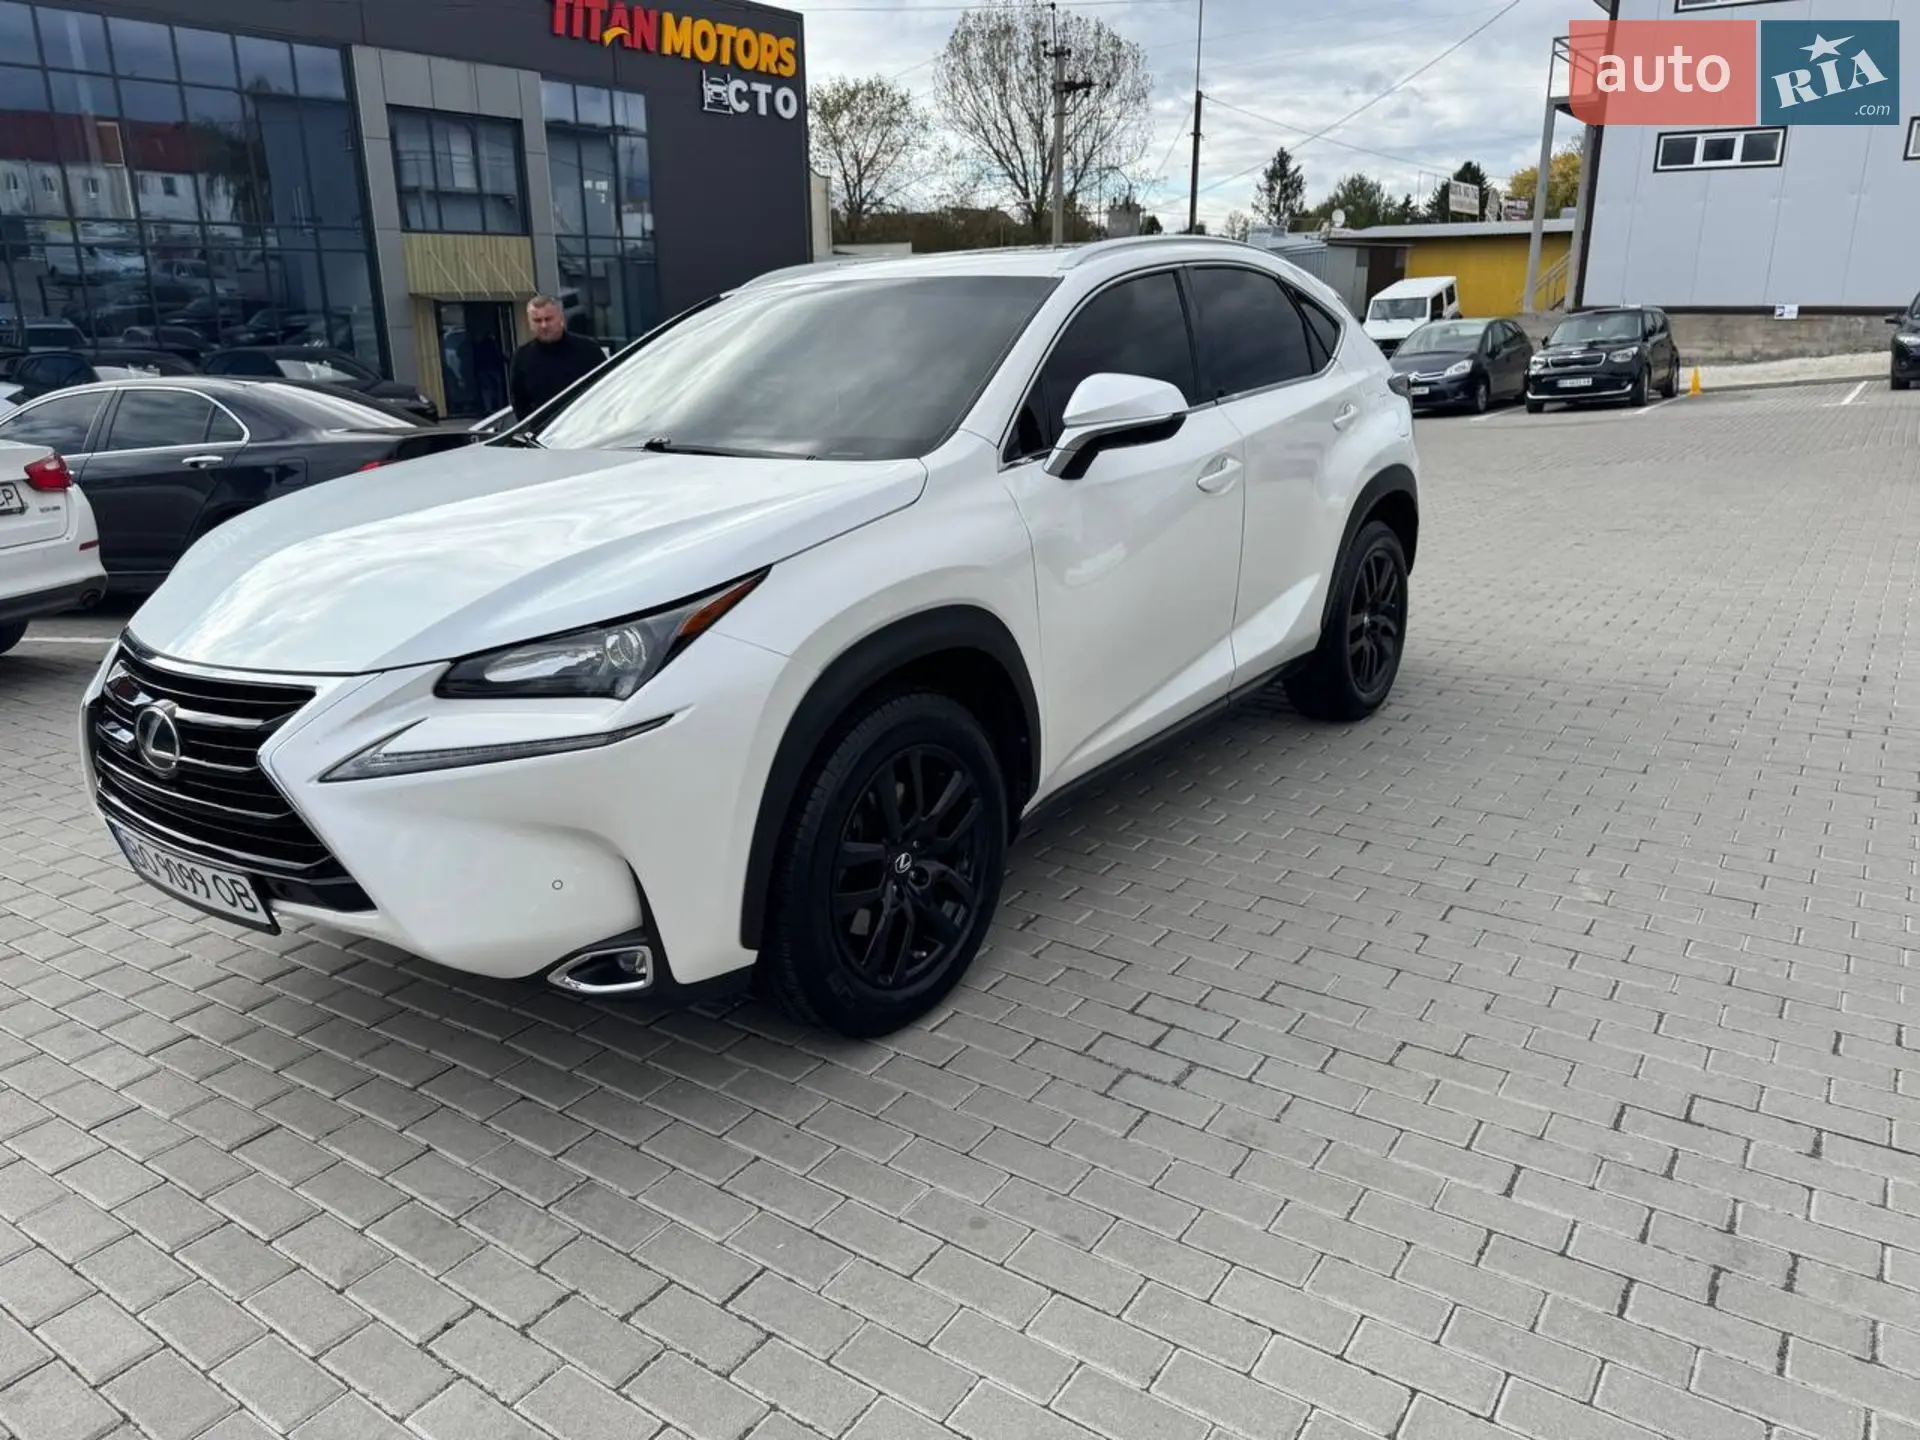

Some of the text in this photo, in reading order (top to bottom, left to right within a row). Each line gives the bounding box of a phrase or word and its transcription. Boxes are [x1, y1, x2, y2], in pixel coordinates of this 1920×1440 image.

[551, 0, 796, 77] TITAN MOTORS
[154, 852, 211, 899] 9099
[211, 874, 258, 913] OB
